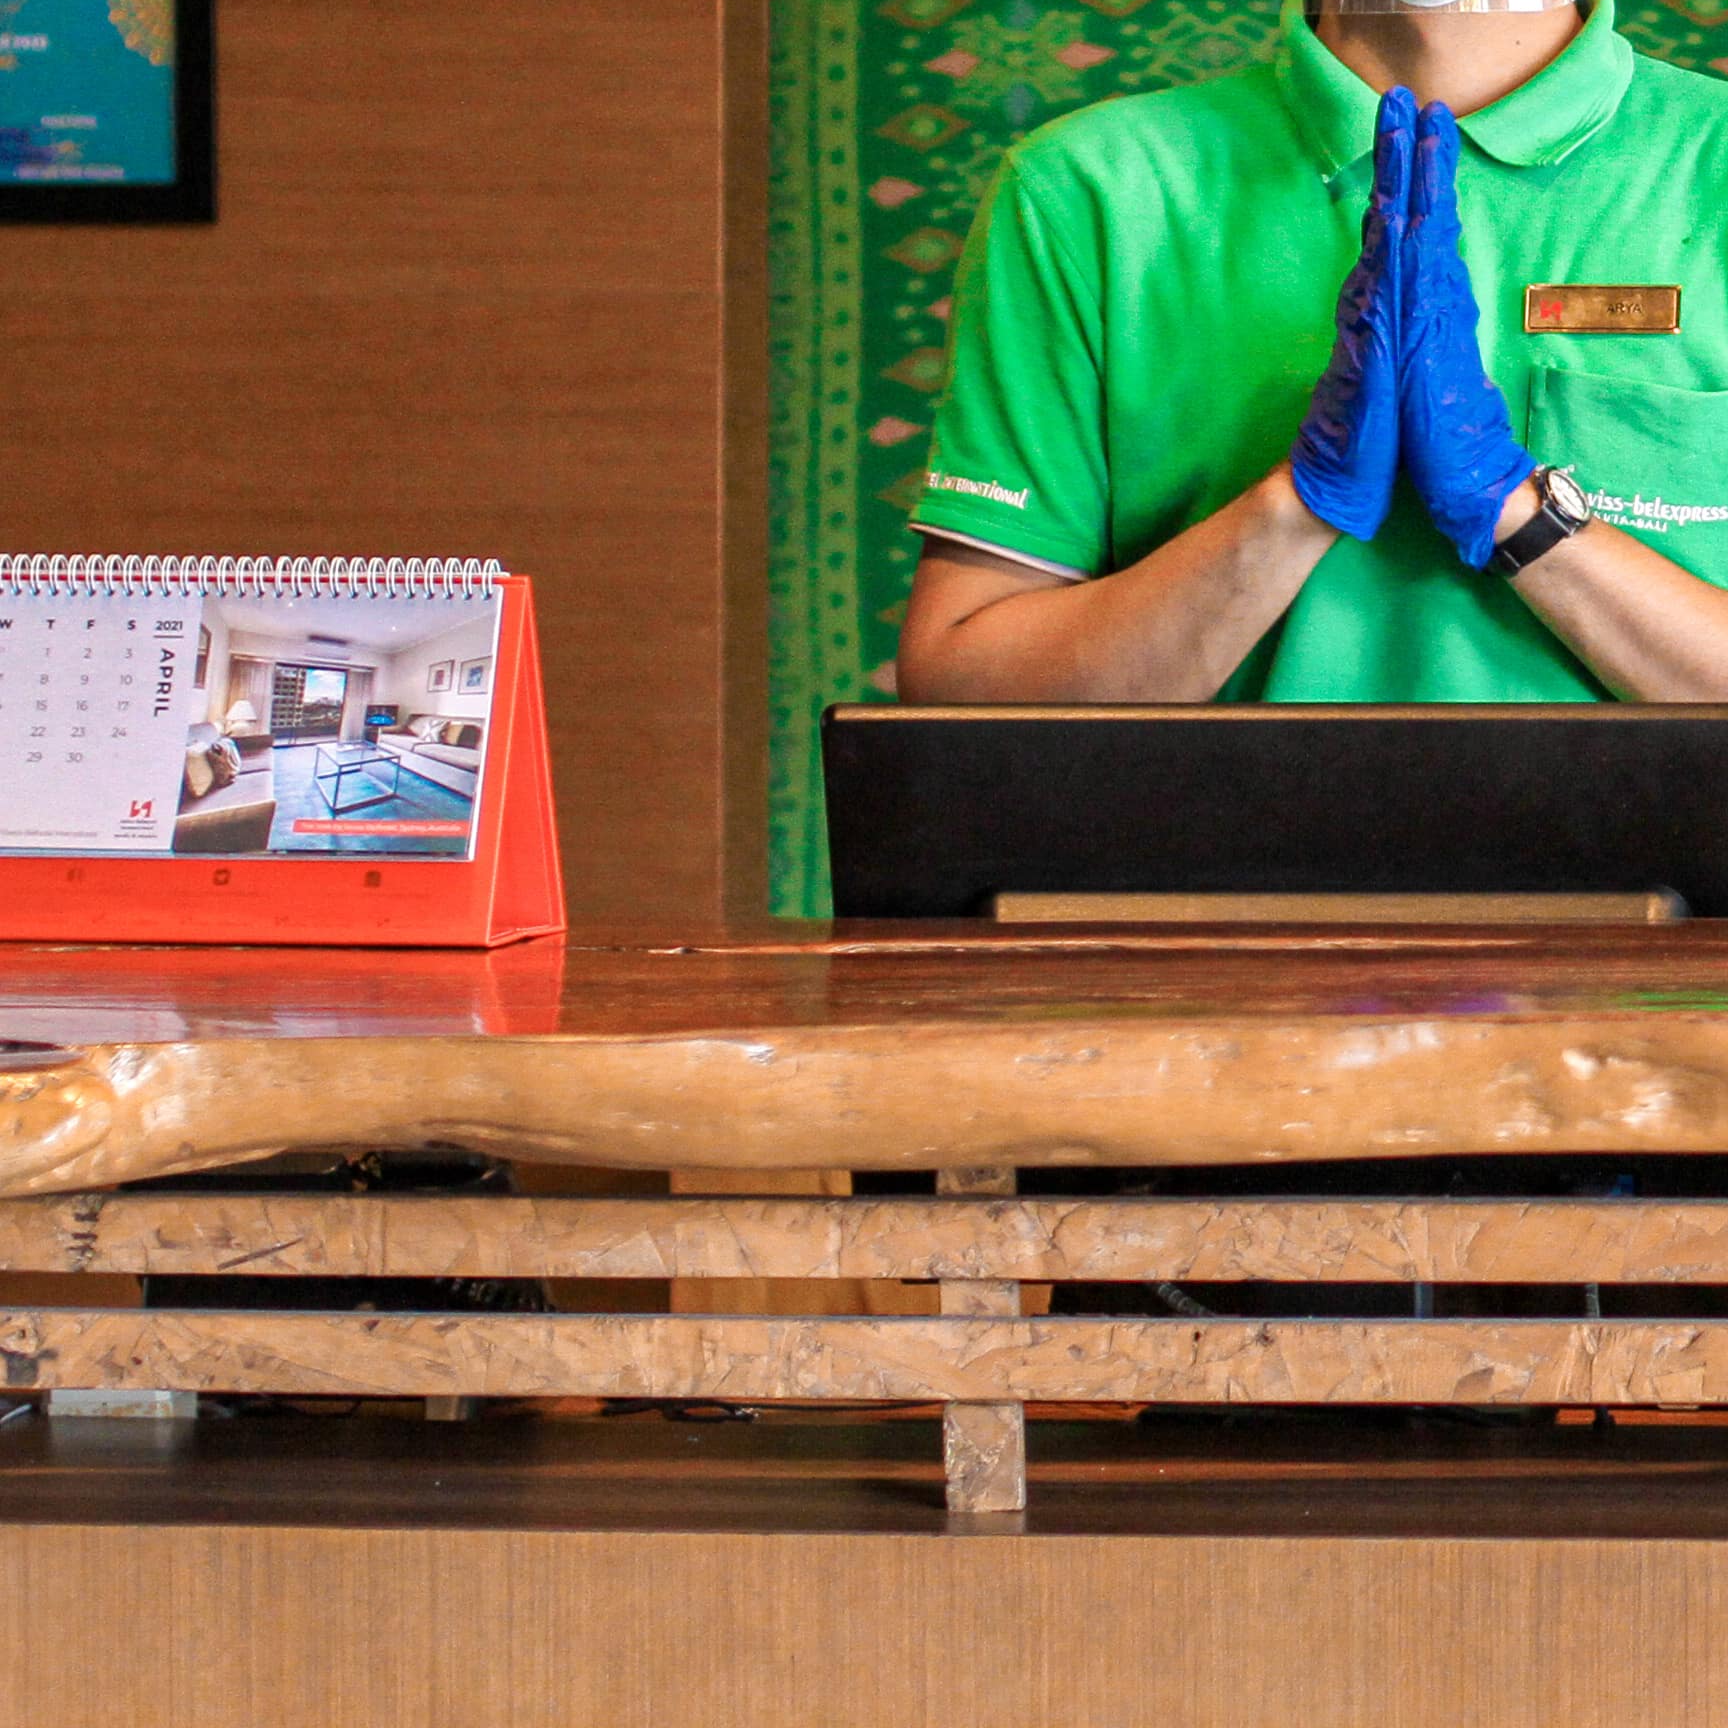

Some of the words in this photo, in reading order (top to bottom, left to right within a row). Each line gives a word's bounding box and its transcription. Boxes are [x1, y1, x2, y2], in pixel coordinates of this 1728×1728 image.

[1606, 302, 1643, 315] ARYA
[46, 619, 56, 630] T
[86, 619, 95, 630] F
[127, 620, 136, 631] S
[155, 620, 184, 631] 2021
[44, 647, 51, 658] 1
[83, 648, 92, 659] 2
[125, 648, 133, 659] 3
[39, 674, 49, 685] 8
[80, 674, 89, 685] 9
[120, 674, 133, 685] 10
[153, 647, 175, 717] APRIL
[36, 700, 48, 711] 15
[76, 700, 89, 711] 16
[117, 701, 129, 711] 17
[30, 726, 46, 737] 22
[70, 727, 86, 738] 23
[111, 727, 127, 738] 24
[26, 752, 43, 763] 29
[66, 752, 83, 763] 30
